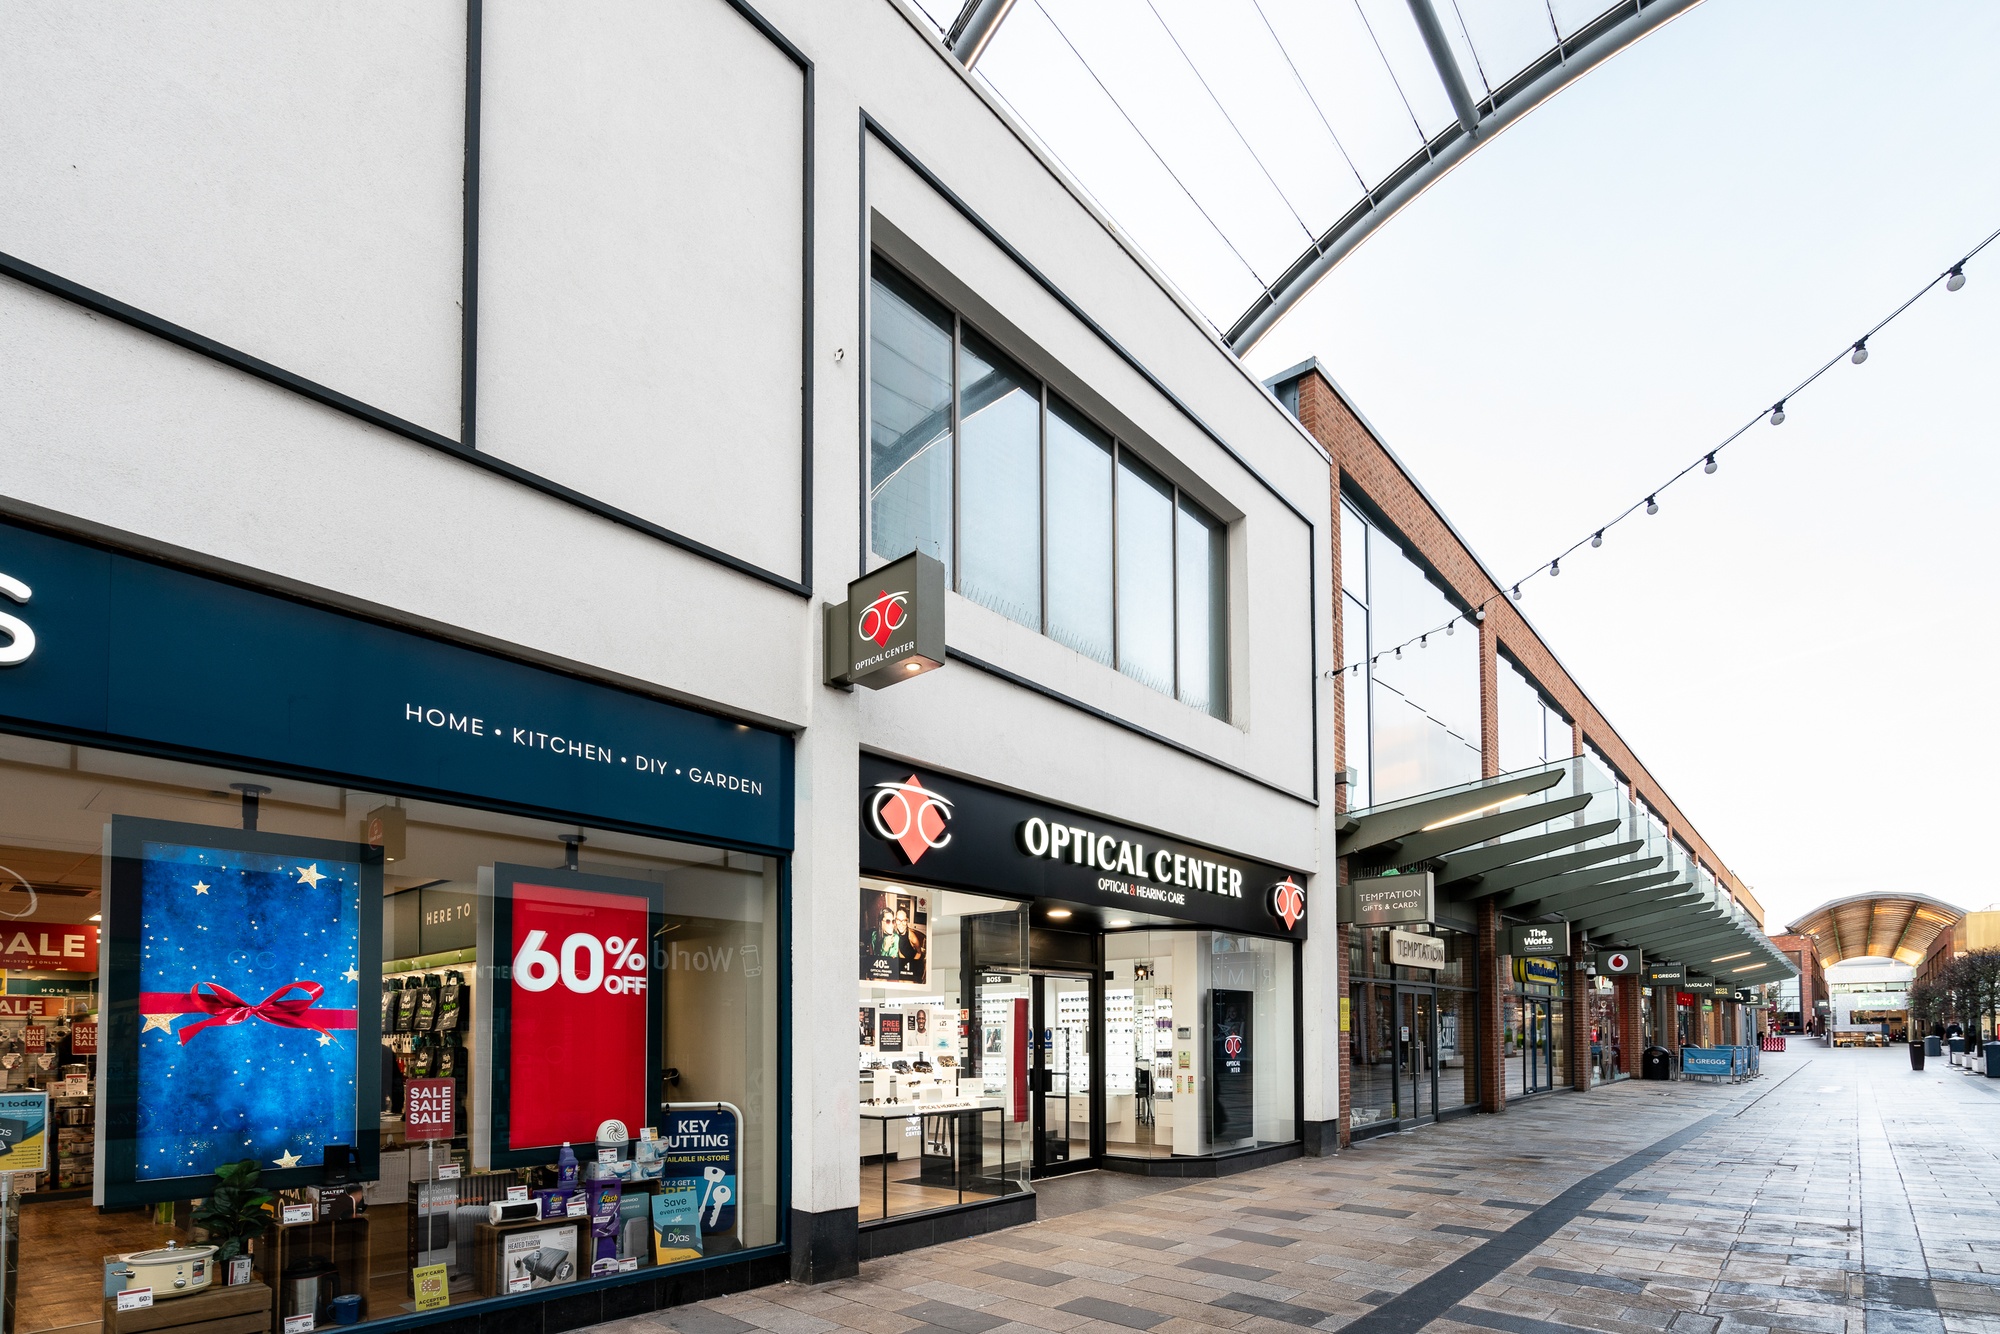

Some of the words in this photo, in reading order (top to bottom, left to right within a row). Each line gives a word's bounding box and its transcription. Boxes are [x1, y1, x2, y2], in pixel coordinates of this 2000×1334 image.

[856, 654, 884, 670] OPTICAL
[885, 641, 914, 658] CENTER
[406, 703, 484, 736] HOME
[514, 727, 612, 764] KITCHEN
[636, 756, 668, 775] DIY
[689, 768, 762, 796] GARDEN
[1024, 816, 1148, 878] OPTICAL
[1154, 850, 1242, 898] CENTER
[1098, 878, 1129, 894] OPTICAL
[1130, 884, 1136, 896] &
[1136, 886, 1167, 902] HEARING
[1168, 892, 1185, 905] CARE
[1360, 889, 1421, 902] TEMPTATION
[1392, 901, 1418, 909] CARDS
[426, 908, 452, 926] HERE
[457, 903, 470, 919] TO
[1530, 929, 1547, 937] The
[0, 932, 86, 958] ALE
[1524, 937, 1553, 946] Works
[1396, 939, 1444, 962] TEMPTATION
[514, 930, 646, 993] 60%
[604, 975, 646, 995] OFF
[410, 1086, 451, 1099] SALE
[410, 1099, 450, 1112] SALE
[410, 1112, 450, 1124] SALE
[678, 1120, 710, 1133] KEY
[601, 1194, 618, 1203] Flash
[664, 1198, 687, 1207] Save
[668, 1233, 690, 1243] Dyas
[508, 1241, 525, 1249] HEATED
[419, 1296, 446, 1305] ACCEPTED
